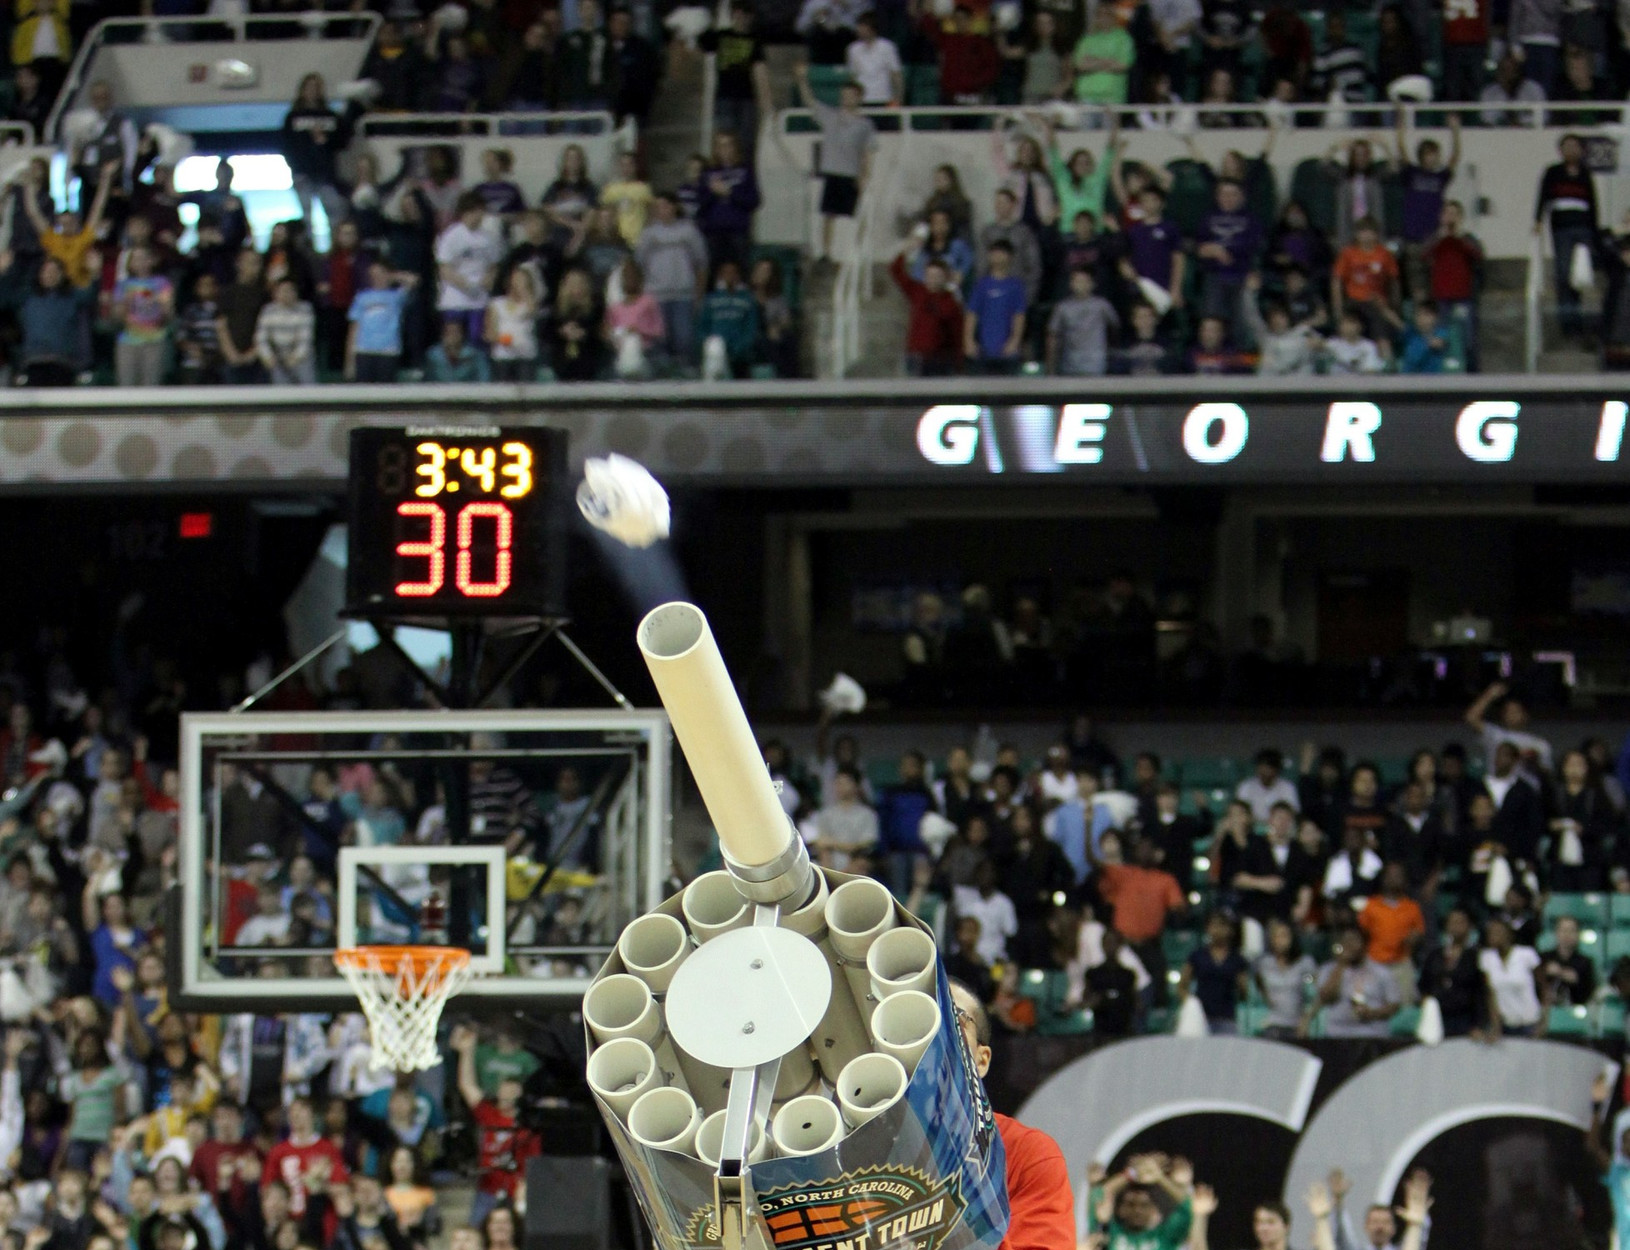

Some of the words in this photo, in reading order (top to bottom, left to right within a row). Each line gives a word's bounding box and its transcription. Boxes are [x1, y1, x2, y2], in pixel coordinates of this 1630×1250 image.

[415, 442, 534, 497] 3:43
[395, 503, 513, 597] 30
[780, 1187, 845, 1206] NORTH
[849, 1181, 915, 1201] CAROLINA
[877, 1198, 944, 1245] TOWN
